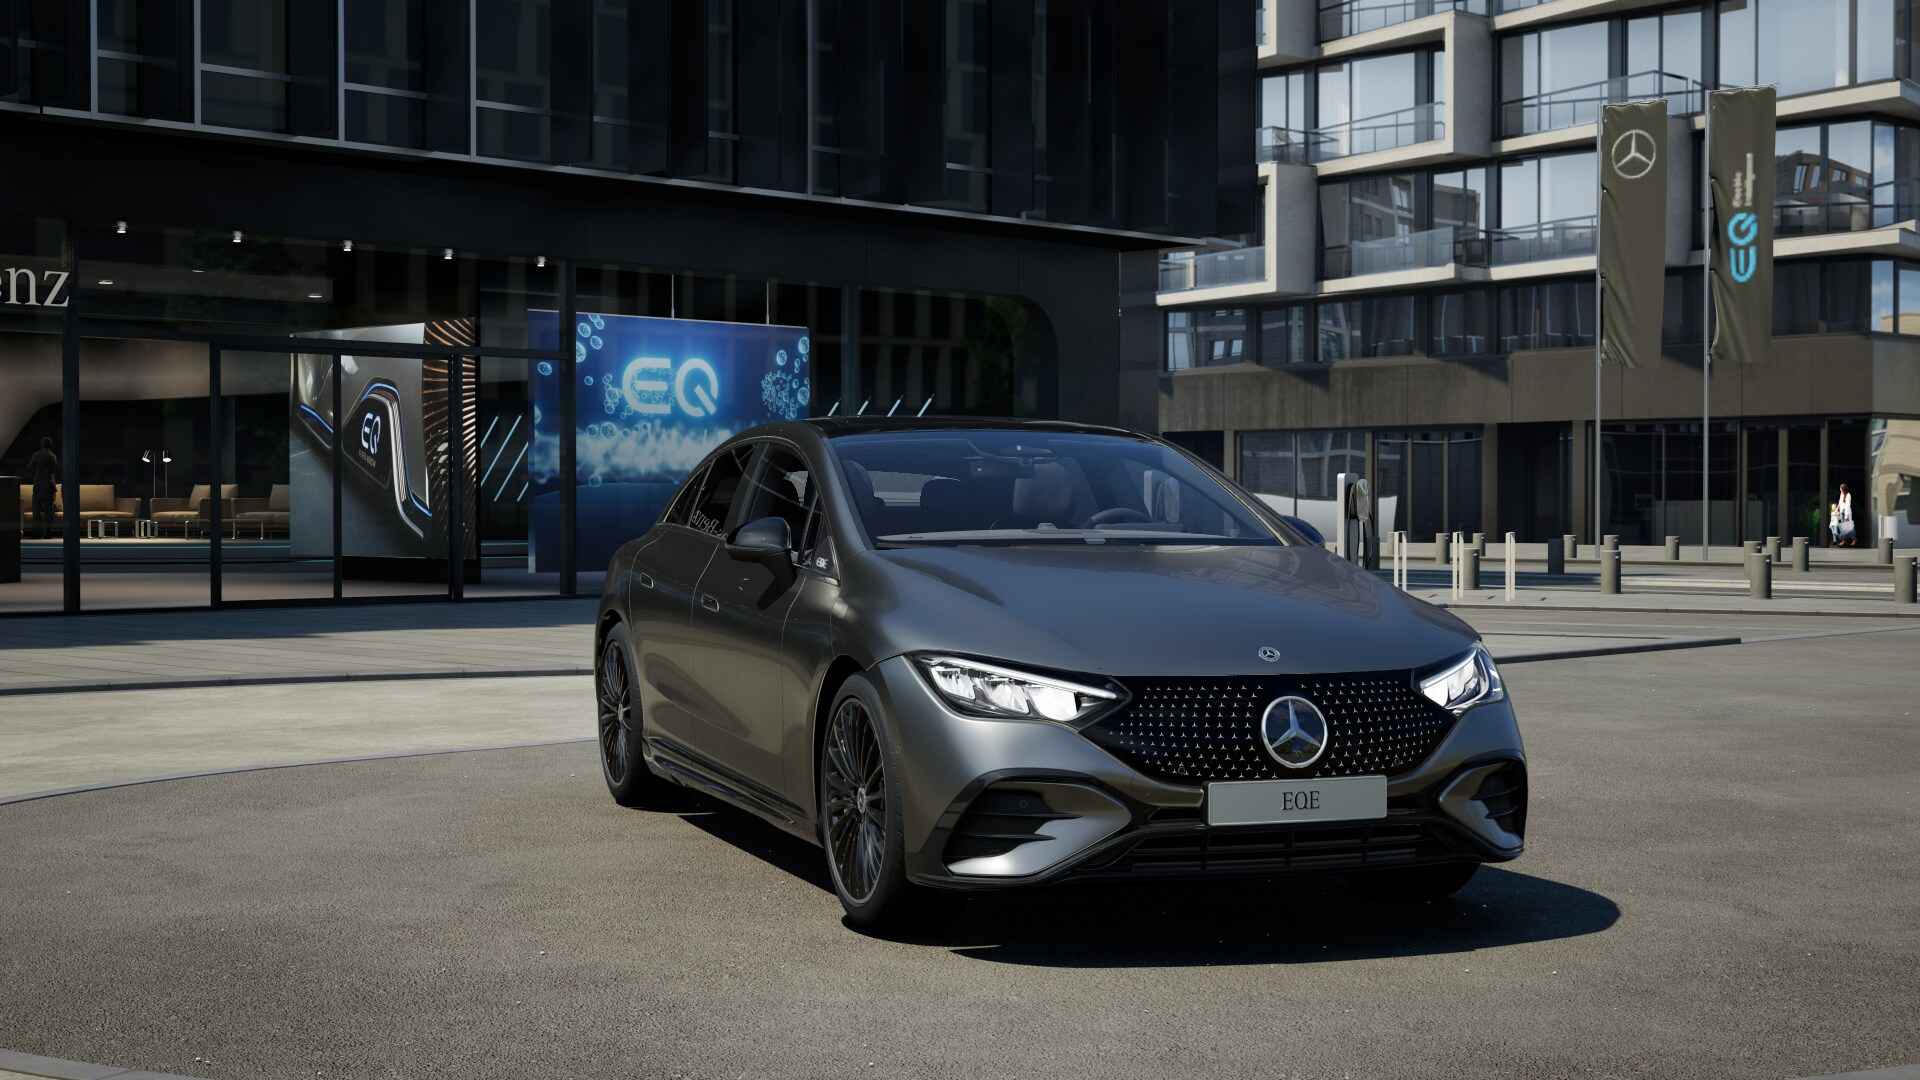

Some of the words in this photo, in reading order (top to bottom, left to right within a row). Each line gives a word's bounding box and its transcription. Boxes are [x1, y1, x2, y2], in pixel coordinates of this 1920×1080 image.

[1728, 212, 1758, 283] EQ
[0, 267, 70, 307] nz
[623, 357, 718, 416] EQ
[361, 412, 382, 455] EQ
[1282, 791, 1320, 811] EQE
